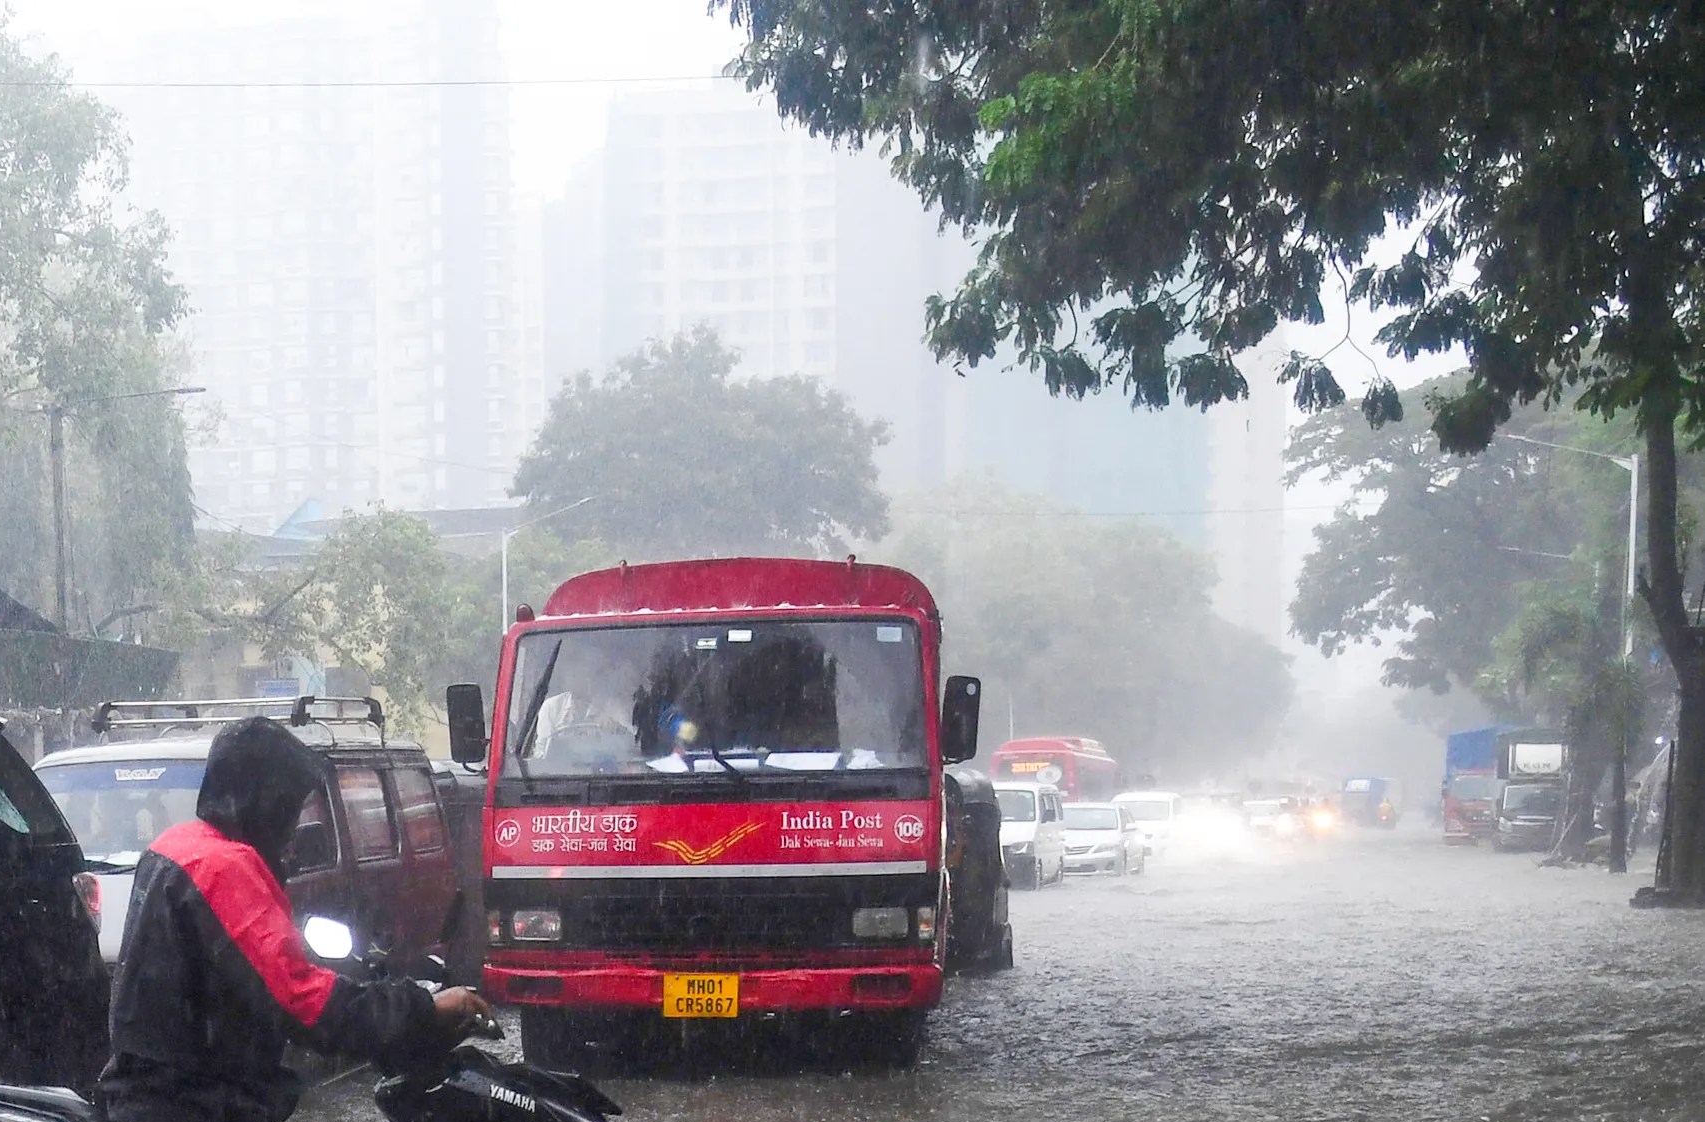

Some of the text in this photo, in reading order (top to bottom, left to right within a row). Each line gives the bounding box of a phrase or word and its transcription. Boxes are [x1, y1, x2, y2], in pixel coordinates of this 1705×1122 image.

[531, 809, 637, 834] भारतीय डाक
[781, 810, 883, 830] India Post
[500, 826, 517, 841] AP
[780, 835, 801, 849] Dak
[836, 834, 855, 848] Jan
[857, 834, 883, 848] Sewa
[531, 838, 554, 852] डाक
[613, 834, 637, 852] सेवा
[687, 979, 723, 995] MH01
[676, 997, 734, 1013] CR5867
[490, 1084, 536, 1113] YAMAHA
